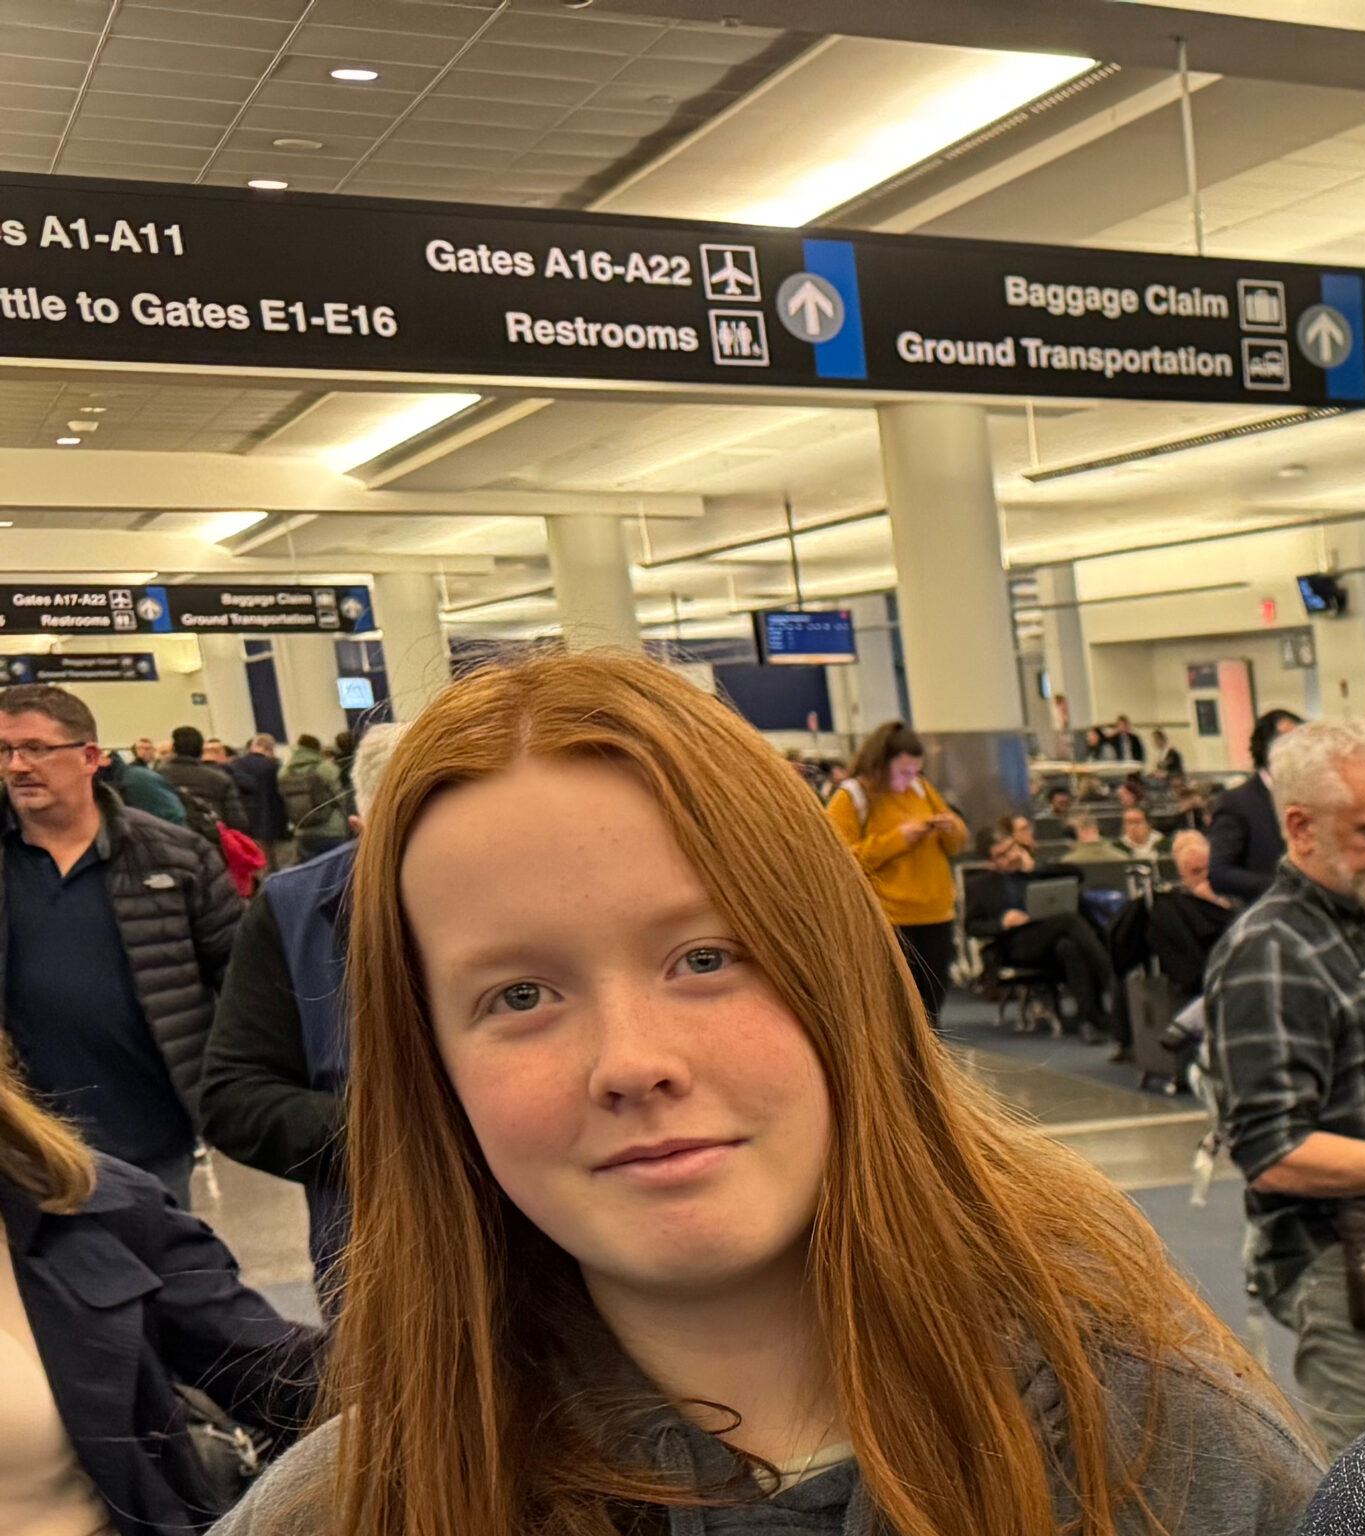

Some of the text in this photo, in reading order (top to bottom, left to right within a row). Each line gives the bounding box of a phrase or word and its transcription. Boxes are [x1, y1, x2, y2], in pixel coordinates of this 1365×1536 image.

[40, 215, 186, 256] A1-A11
[426, 239, 692, 286] Gates A16-A22
[77, 291, 119, 325] to
[131, 292, 250, 330] Gates
[260, 299, 397, 337] E1-E16
[1005, 275, 1229, 318] Baggage Claim
[505, 311, 697, 352] Restrooms
[896, 331, 1233, 377] Ground Transportation
